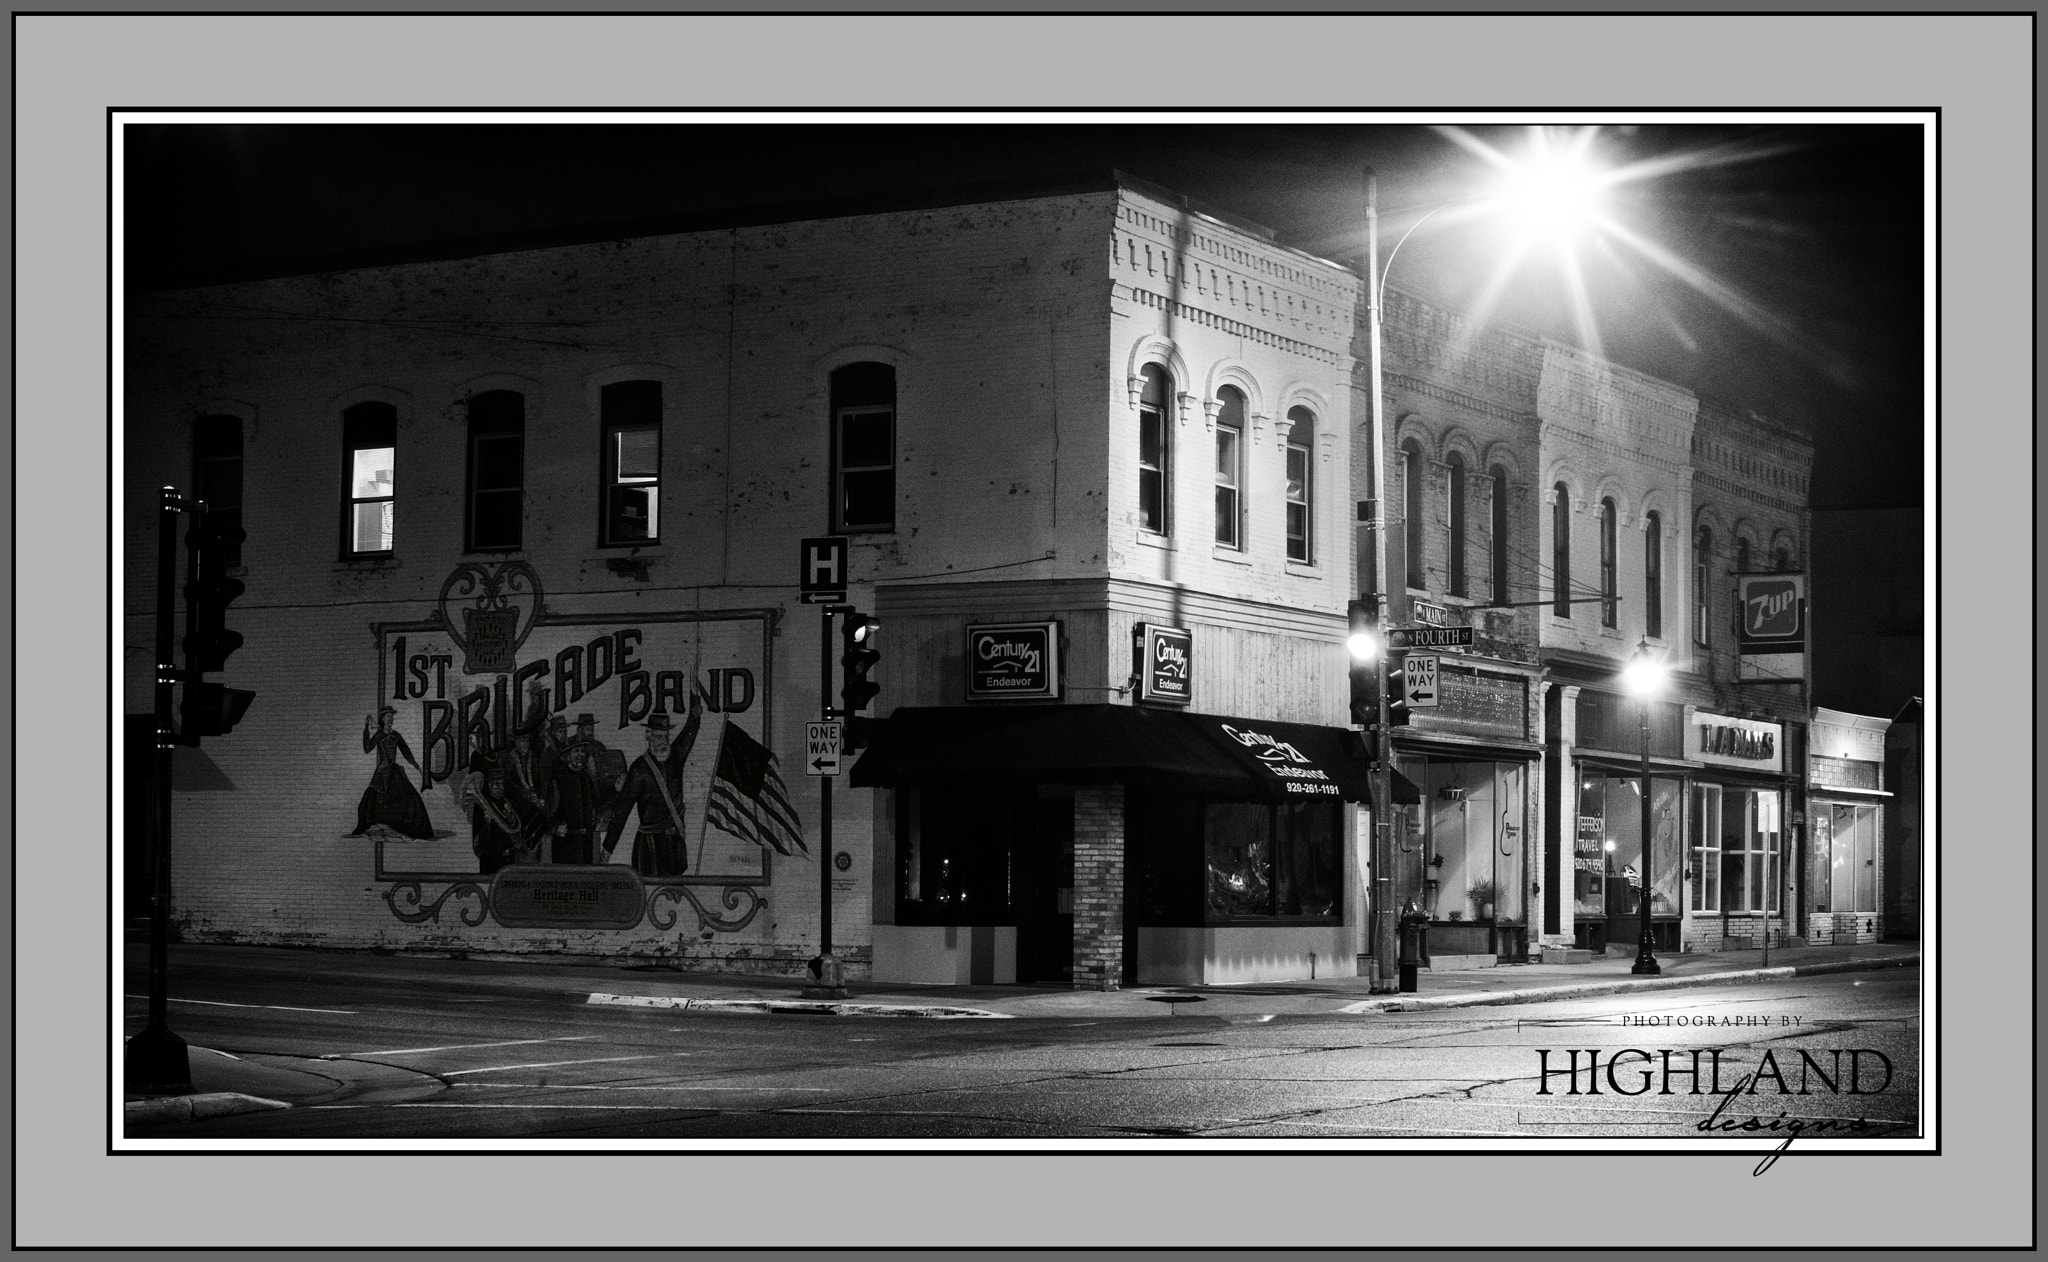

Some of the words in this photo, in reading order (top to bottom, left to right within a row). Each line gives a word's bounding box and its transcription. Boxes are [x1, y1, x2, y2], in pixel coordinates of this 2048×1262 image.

[810, 545, 838, 584] H
[1425, 606, 1442, 624] MAIN
[1748, 589, 1794, 630] 7UP
[1415, 629, 1460, 645] FOURTH
[1462, 632, 1470, 641] ST
[978, 636, 1030, 661] Century
[1023, 650, 1040, 674] 21
[1156, 637, 1183, 664] Century
[1178, 657, 1188, 679] 21
[391, 636, 453, 700] 1ST
[1408, 659, 1434, 672] ONE
[986, 676, 1032, 688] Endeavor
[1159, 678, 1184, 691] Endeavor
[1407, 674, 1435, 687] WAY
[618, 667, 755, 730] BAND
[420, 628, 644, 792] BRIGADE
[810, 726, 837, 739] ONE
[809, 741, 838, 754] WAY
[1221, 724, 1280, 750] Century
[1276, 742, 1313, 763] 21
[1264, 762, 1330, 780] Endeavor
[1286, 782, 1340, 795] 920-261-1191
[1578, 838, 1599, 853] TRAVEL
[533, 888, 575, 903] Heritage
[578, 889, 599, 902] Hall
